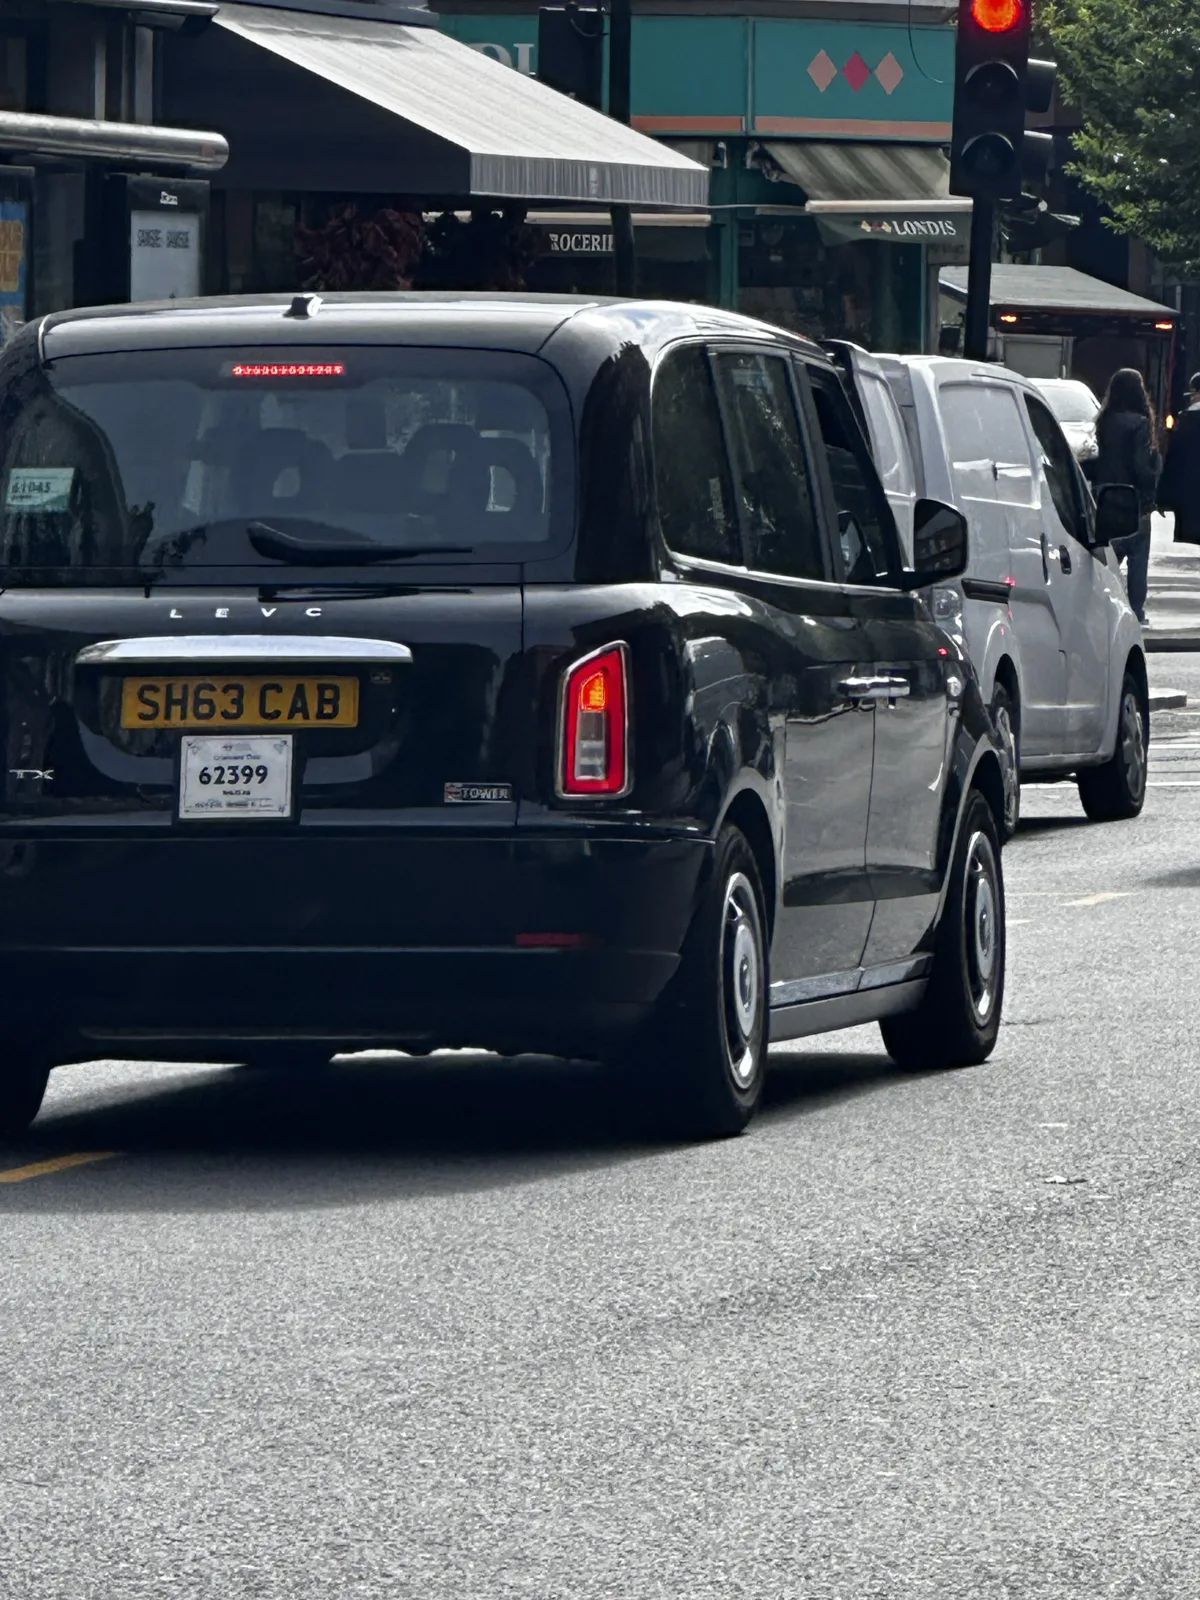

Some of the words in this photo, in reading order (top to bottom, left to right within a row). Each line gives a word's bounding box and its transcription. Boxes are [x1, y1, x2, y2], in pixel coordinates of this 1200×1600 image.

[892, 220, 956, 236] LONDIS
[169, 607, 322, 619] LEVC
[137, 683, 245, 721] SH63
[259, 683, 341, 721] CAB
[9, 769, 54, 780] TX
[198, 765, 268, 785] 62399
